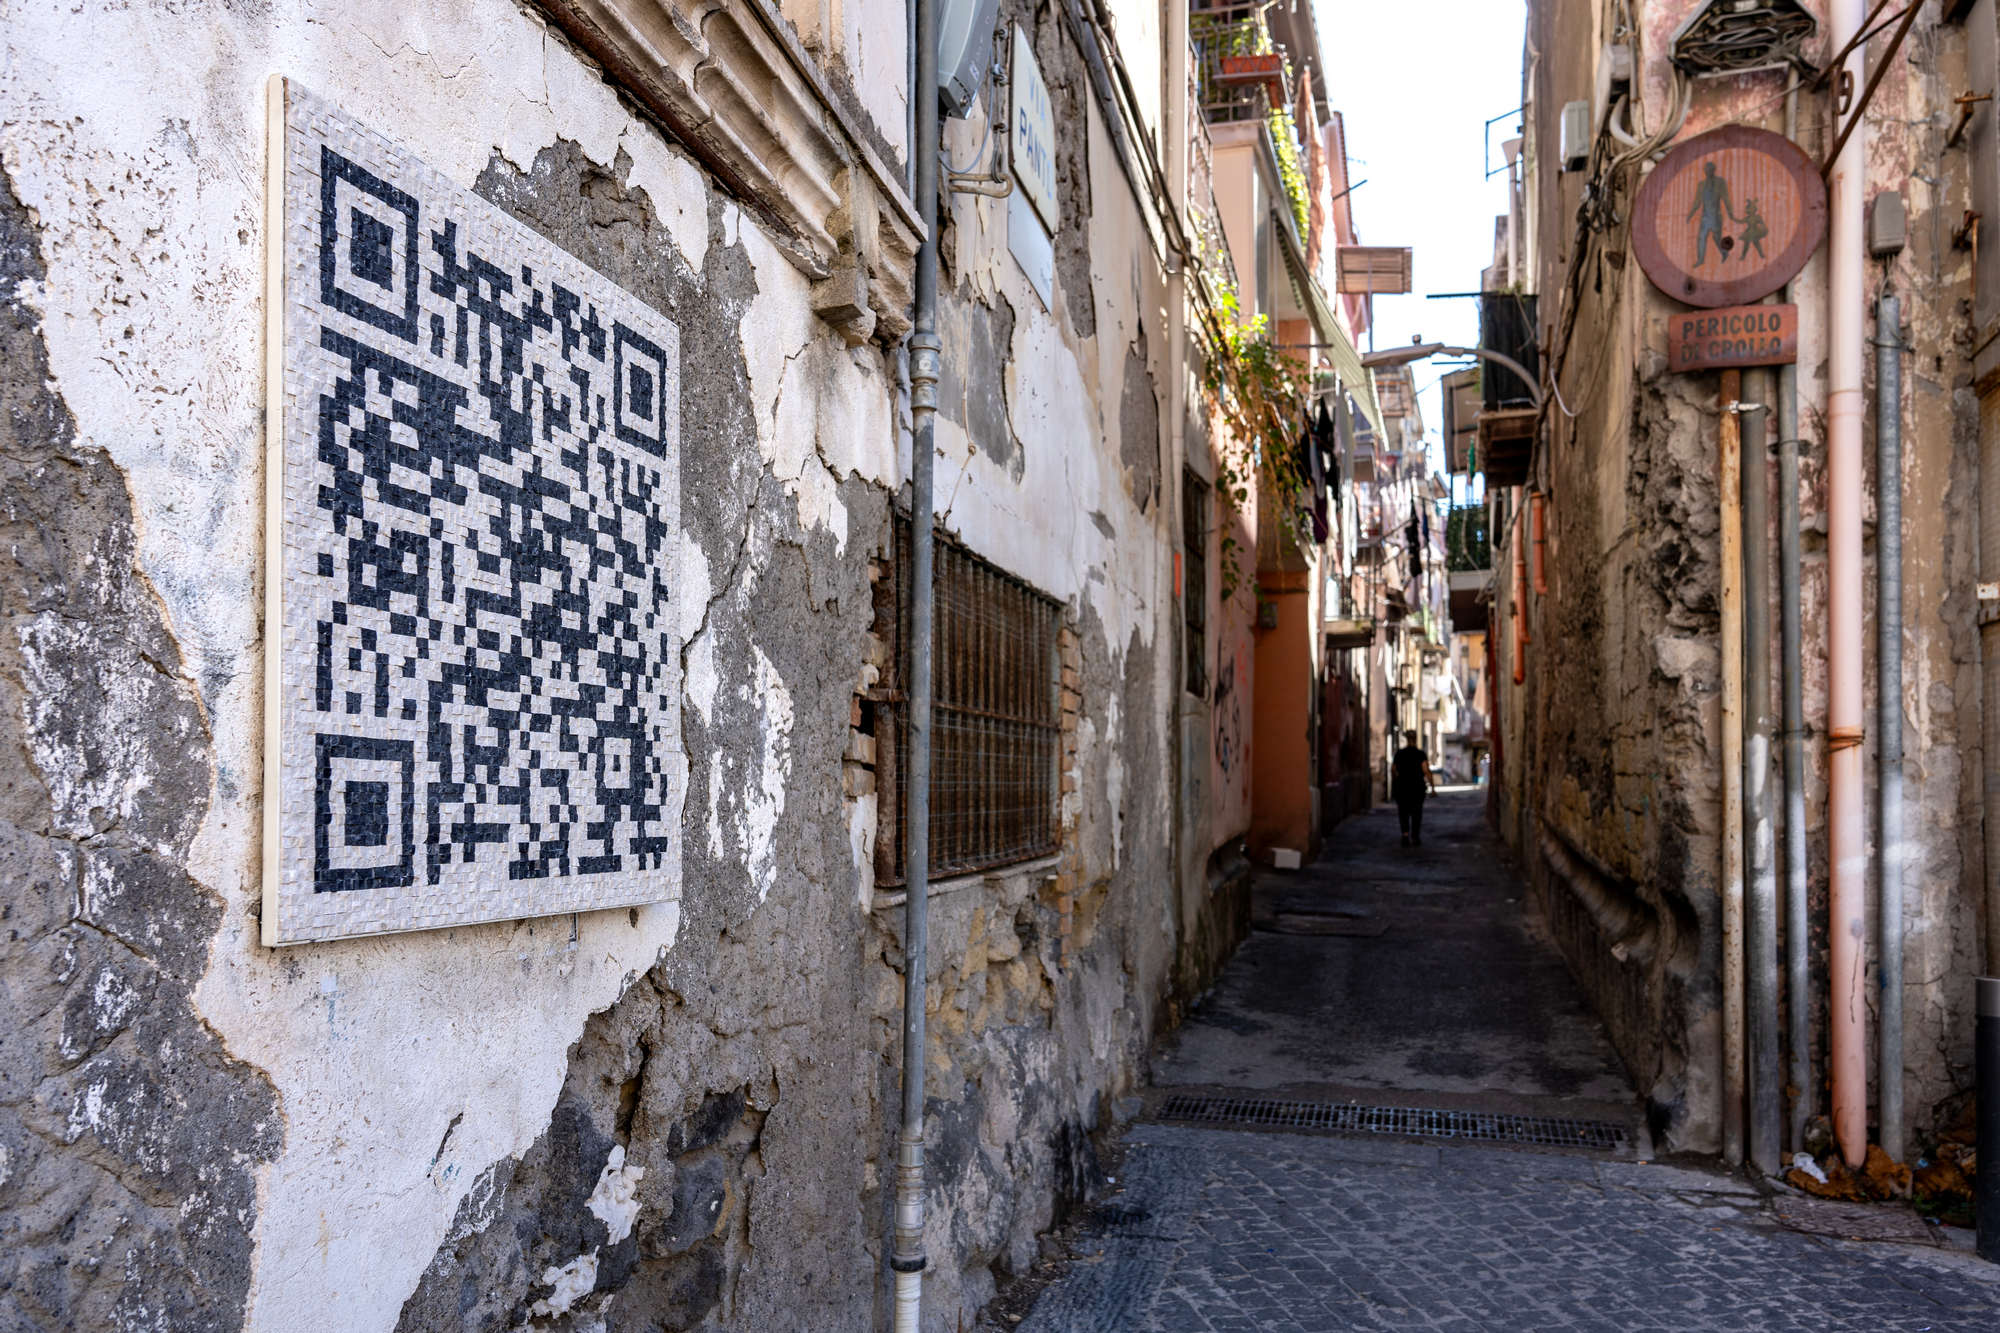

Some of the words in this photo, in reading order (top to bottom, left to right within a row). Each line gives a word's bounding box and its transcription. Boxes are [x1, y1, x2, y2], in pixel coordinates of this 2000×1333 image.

[1028, 66, 1046, 126] VIA
[1682, 312, 1782, 340] PERICOLO
[1681, 342, 1702, 363] DI
[1709, 336, 1782, 360] CROLLO
